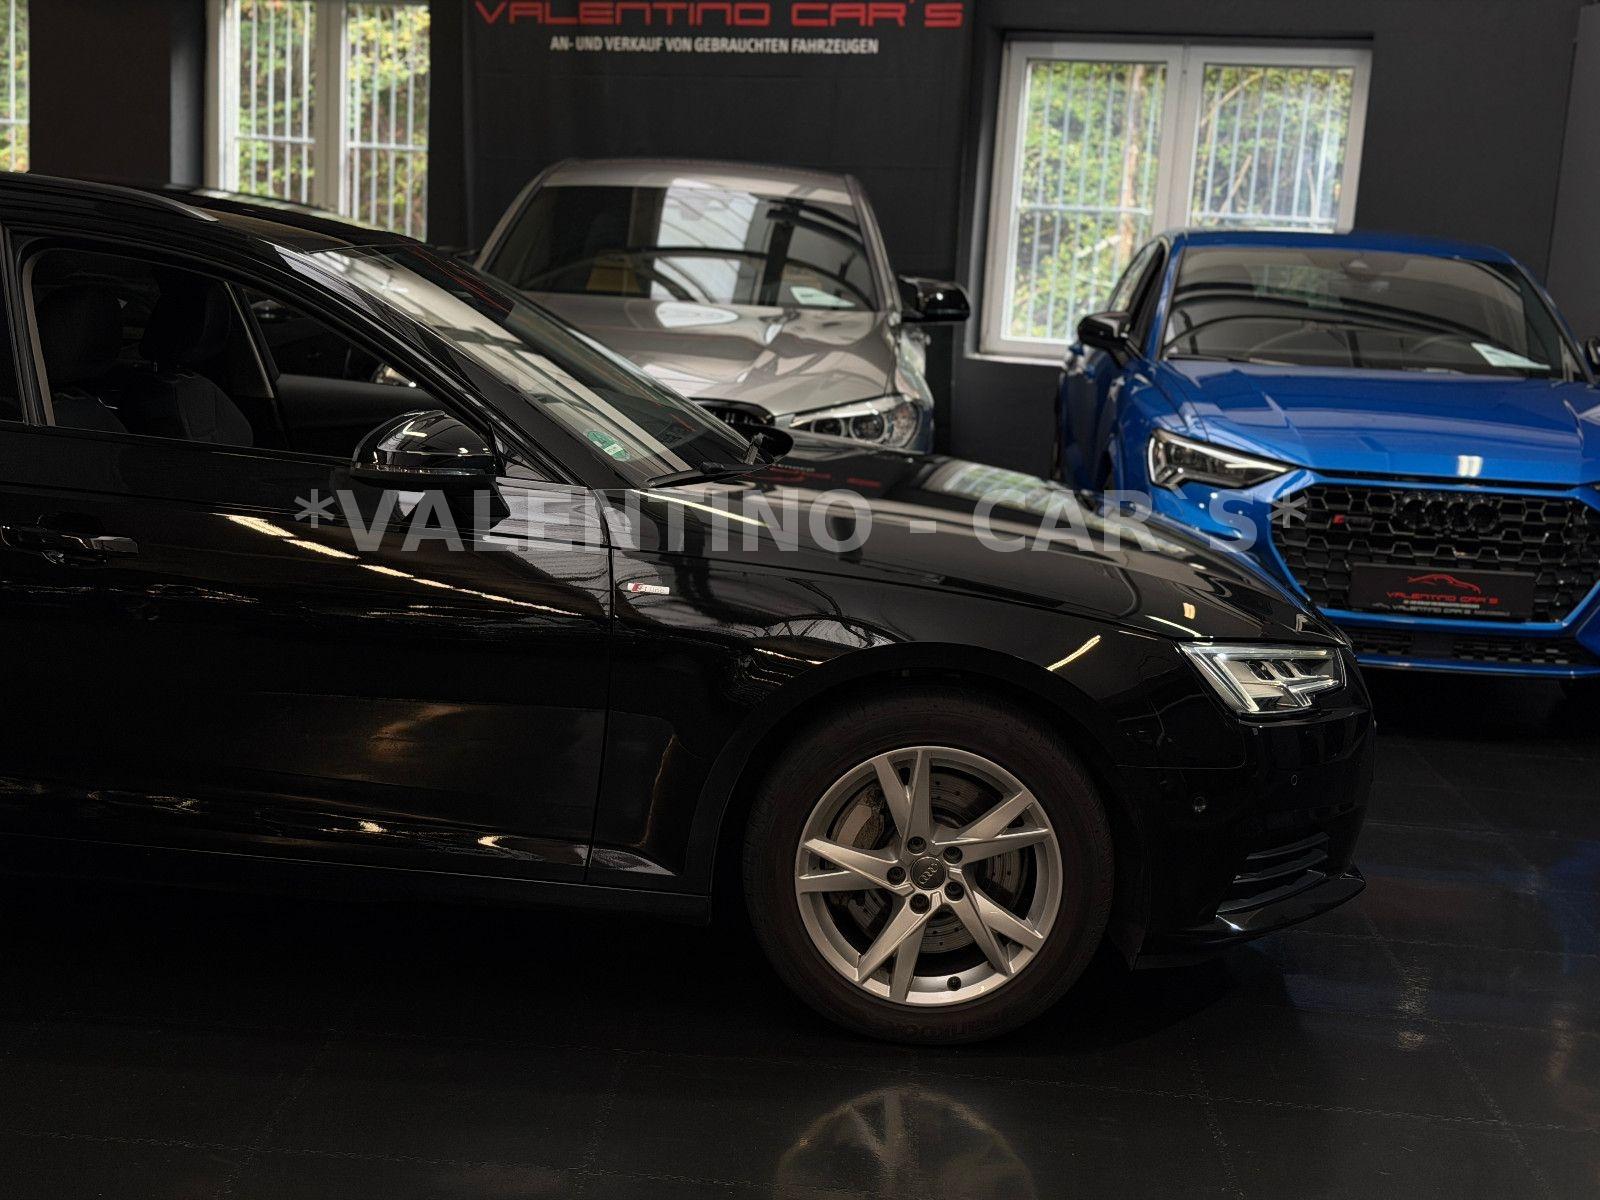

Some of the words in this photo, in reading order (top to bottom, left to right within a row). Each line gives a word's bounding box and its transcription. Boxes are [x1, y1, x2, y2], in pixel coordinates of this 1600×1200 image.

[476, 0, 772, 26] VALENTINO
[550, 36, 574, 51] AN-
[575, 36, 603, 51] UND
[604, 36, 664, 52] VERKAUF
[665, 37, 693, 52] VON
[694, 36, 790, 53] GEBRAUCHTEN
[790, 38, 880, 54] FAHRZEUGEN
